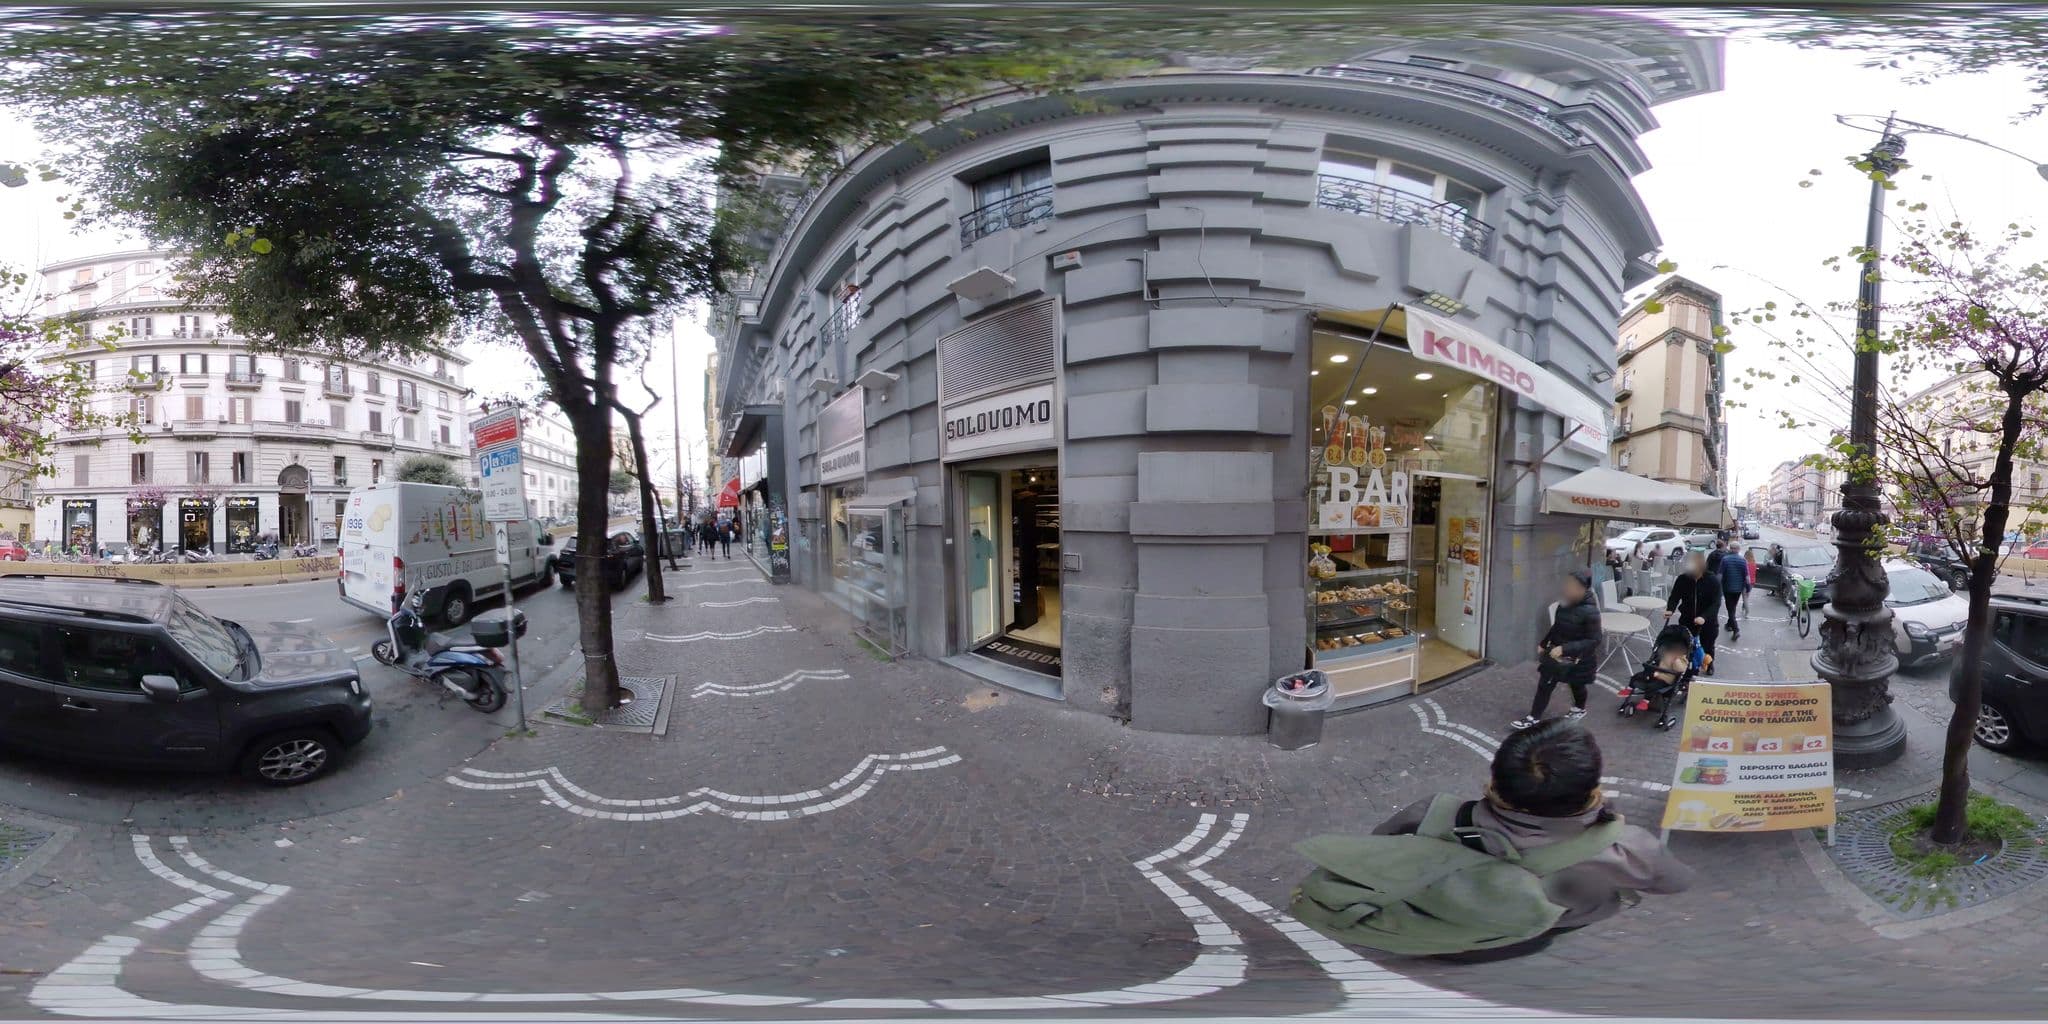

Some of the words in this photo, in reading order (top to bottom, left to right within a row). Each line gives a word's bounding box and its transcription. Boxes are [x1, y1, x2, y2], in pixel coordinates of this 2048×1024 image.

[1423, 330, 1535, 393] KIMBO
[946, 400, 1051, 439] SOLOUOMO
[1327, 466, 1409, 504] BAR
[1571, 496, 1621, 508] KIMBO
[347, 518, 363, 529] 1936
[427, 563, 452, 579] GUSTO
[986, 641, 1062, 666] SOLOUOM
[1765, 698, 1818, 706] D'ASPORTO
[1704, 708, 1744, 717] APEROL
[1699, 715, 1745, 724] COUNTER
[1767, 716, 1817, 724] TAKEAWAY
[1788, 761, 1827, 769] BAGAGLI
[1787, 771, 1827, 779] STORAGE
